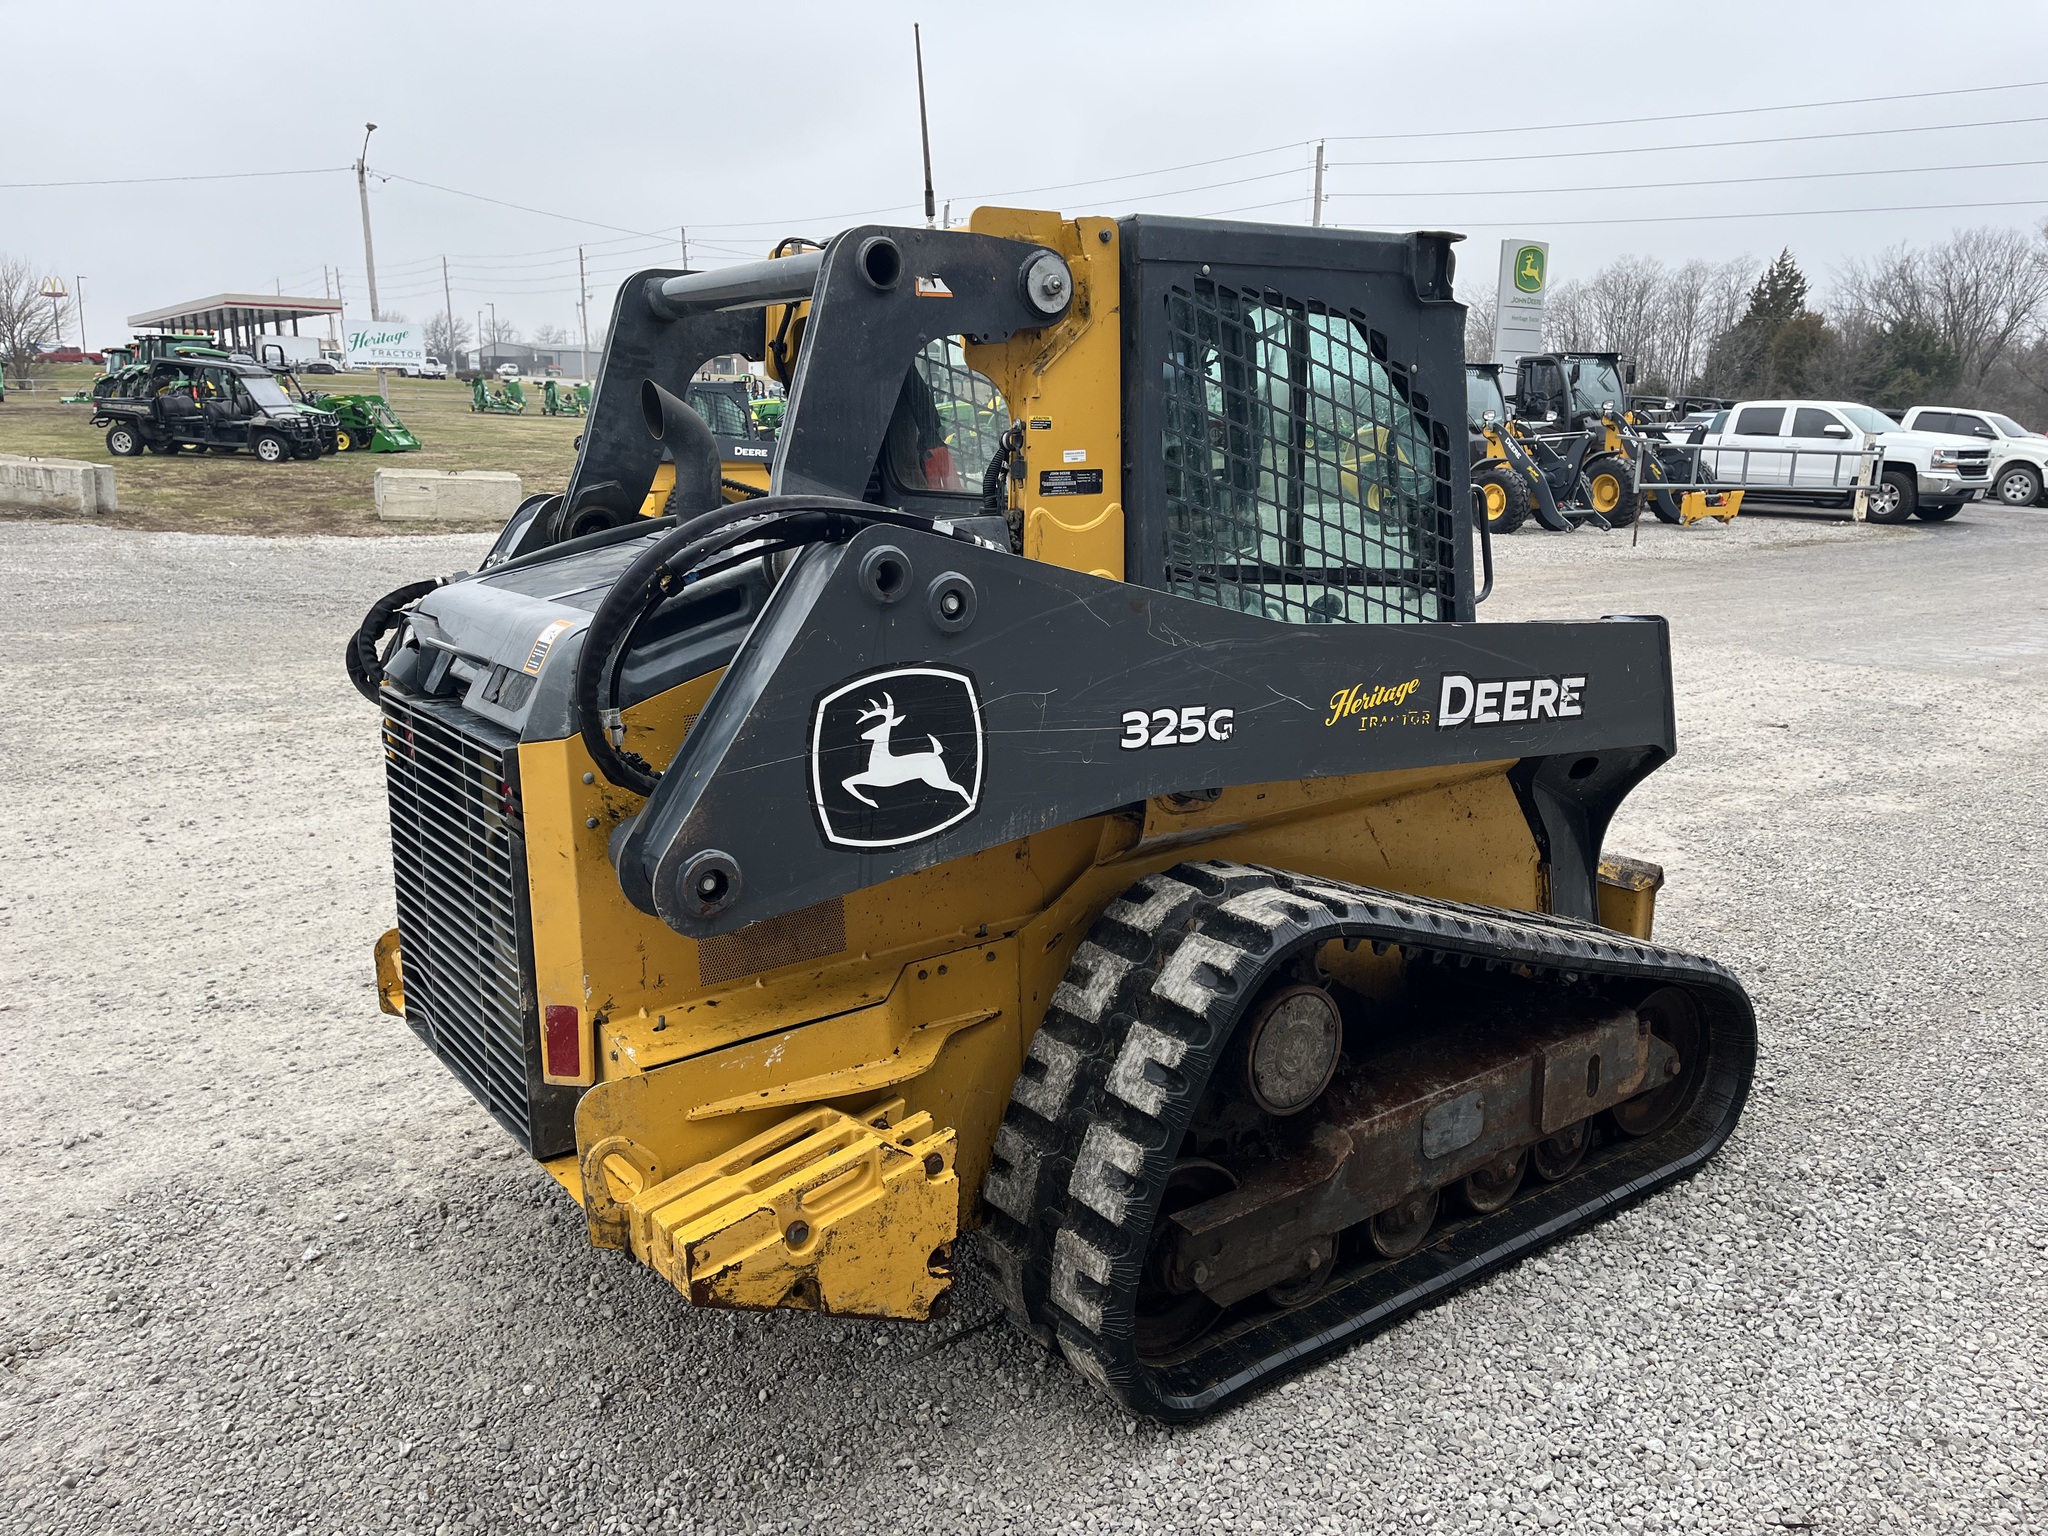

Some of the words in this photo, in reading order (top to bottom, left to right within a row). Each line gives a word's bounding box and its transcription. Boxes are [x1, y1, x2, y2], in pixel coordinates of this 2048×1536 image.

[1511, 296, 1527, 304] JOHN
[1527, 297, 1542, 306] DEERE
[347, 329, 409, 352] Heritage
[371, 349, 422, 358] TRACTOR
[734, 446, 768, 457] DEERE
[1504, 436, 1522, 460] DEERE
[1324, 678, 1420, 727] Heritage
[1438, 675, 1586, 728] DEERE
[1120, 706, 1234, 749] 325G
